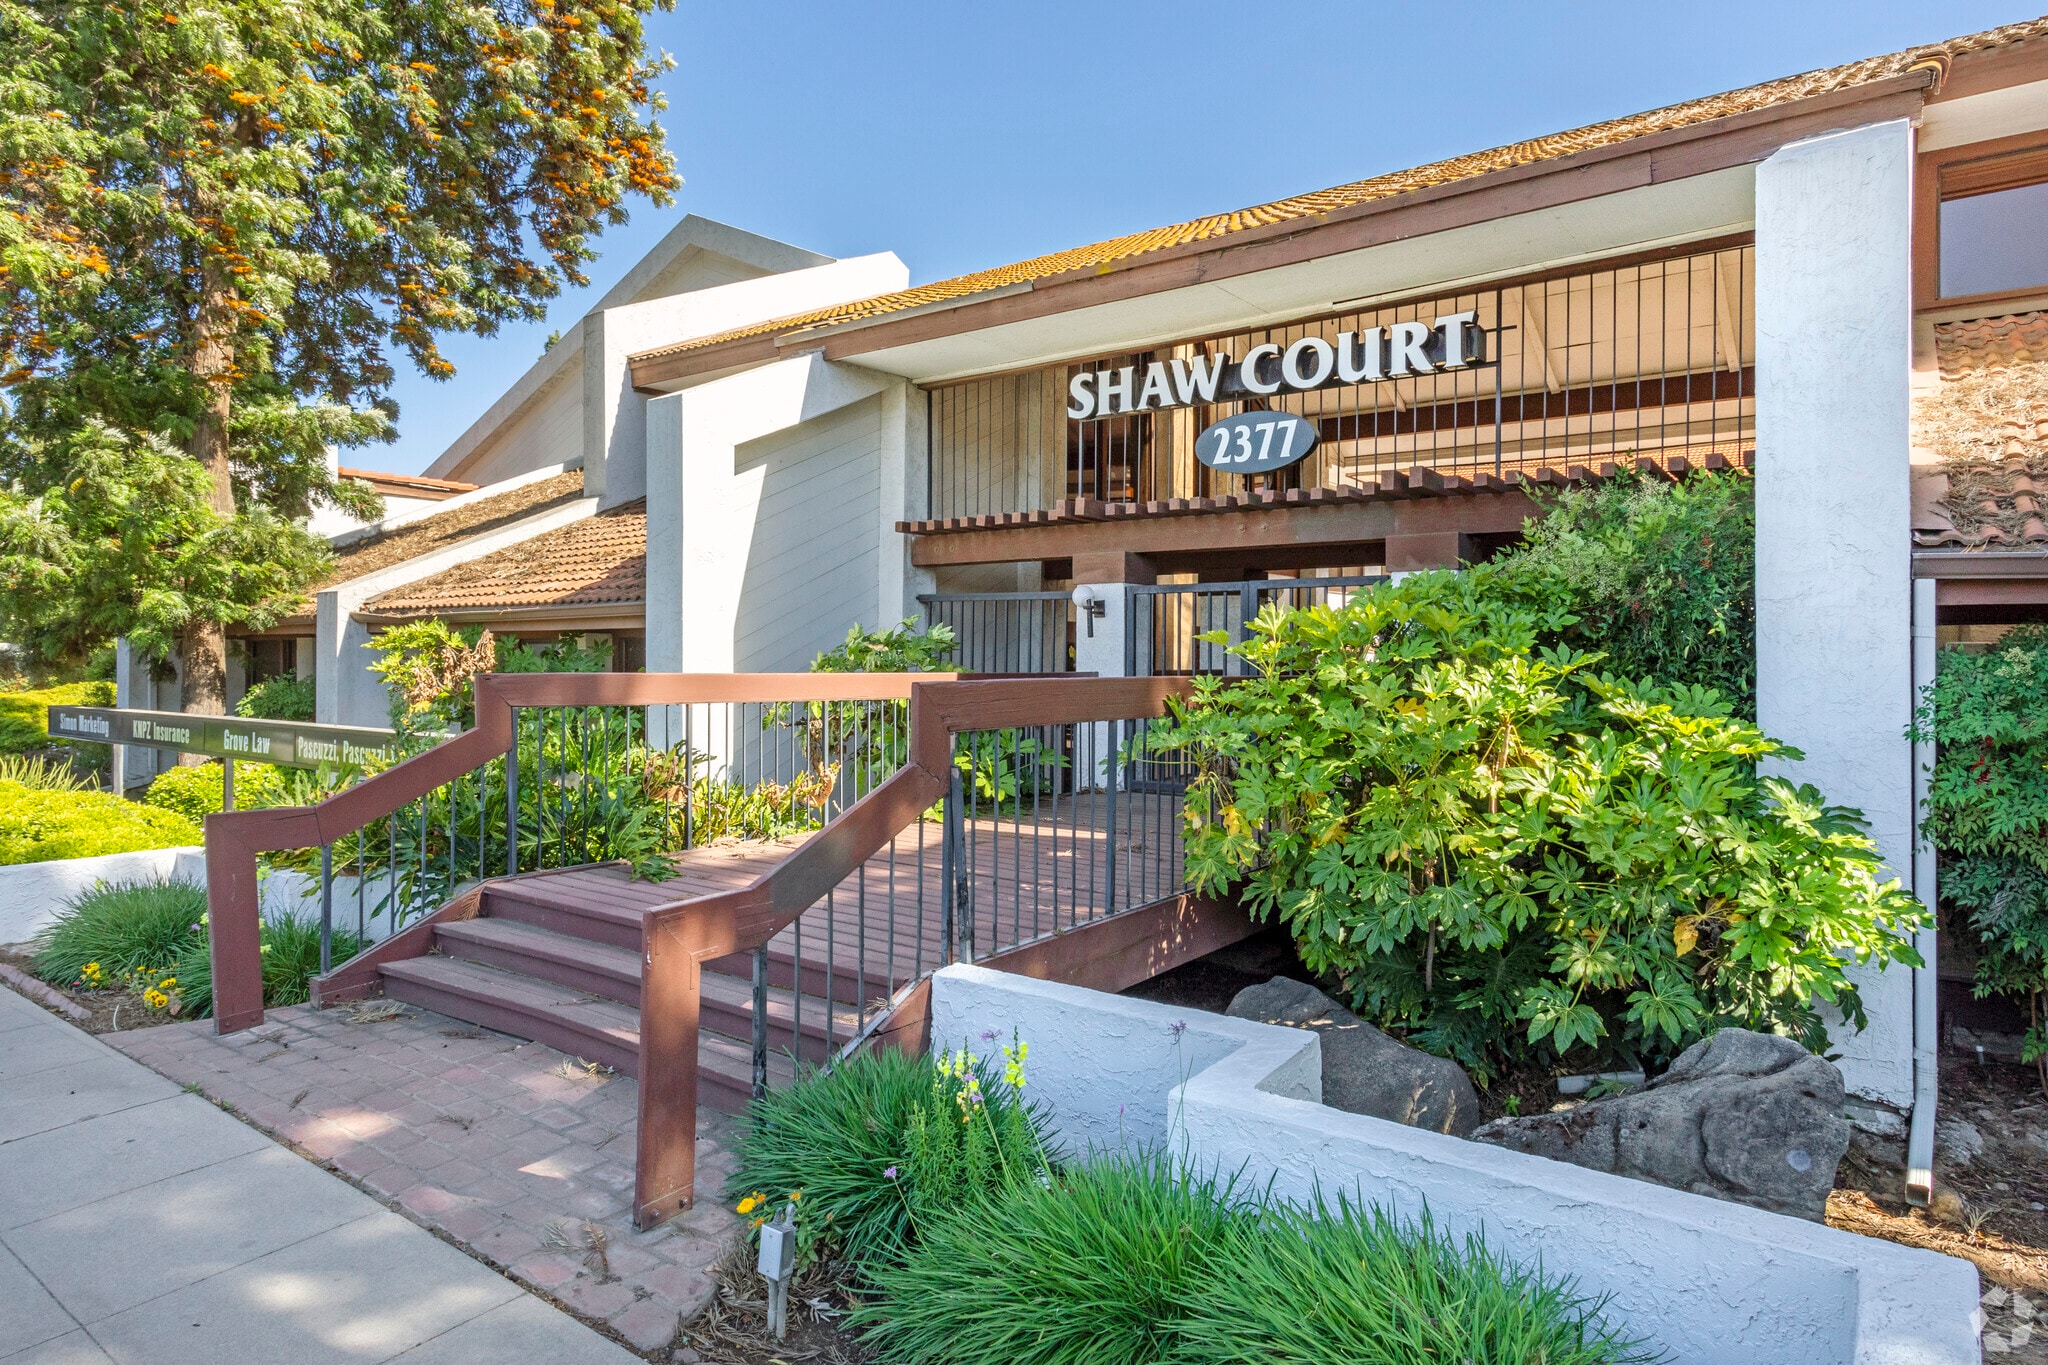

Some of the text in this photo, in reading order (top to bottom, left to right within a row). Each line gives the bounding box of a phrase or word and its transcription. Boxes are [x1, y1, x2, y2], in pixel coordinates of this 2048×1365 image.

[1068, 310, 1479, 420] SHAW COURT
[1212, 419, 1298, 465] 2377
[60, 713, 110, 738] Simon Marketing
[153, 722, 190, 744] Insurance
[223, 729, 270, 754] Grove Law
[298, 736, 339, 765] Pascuzzi,
